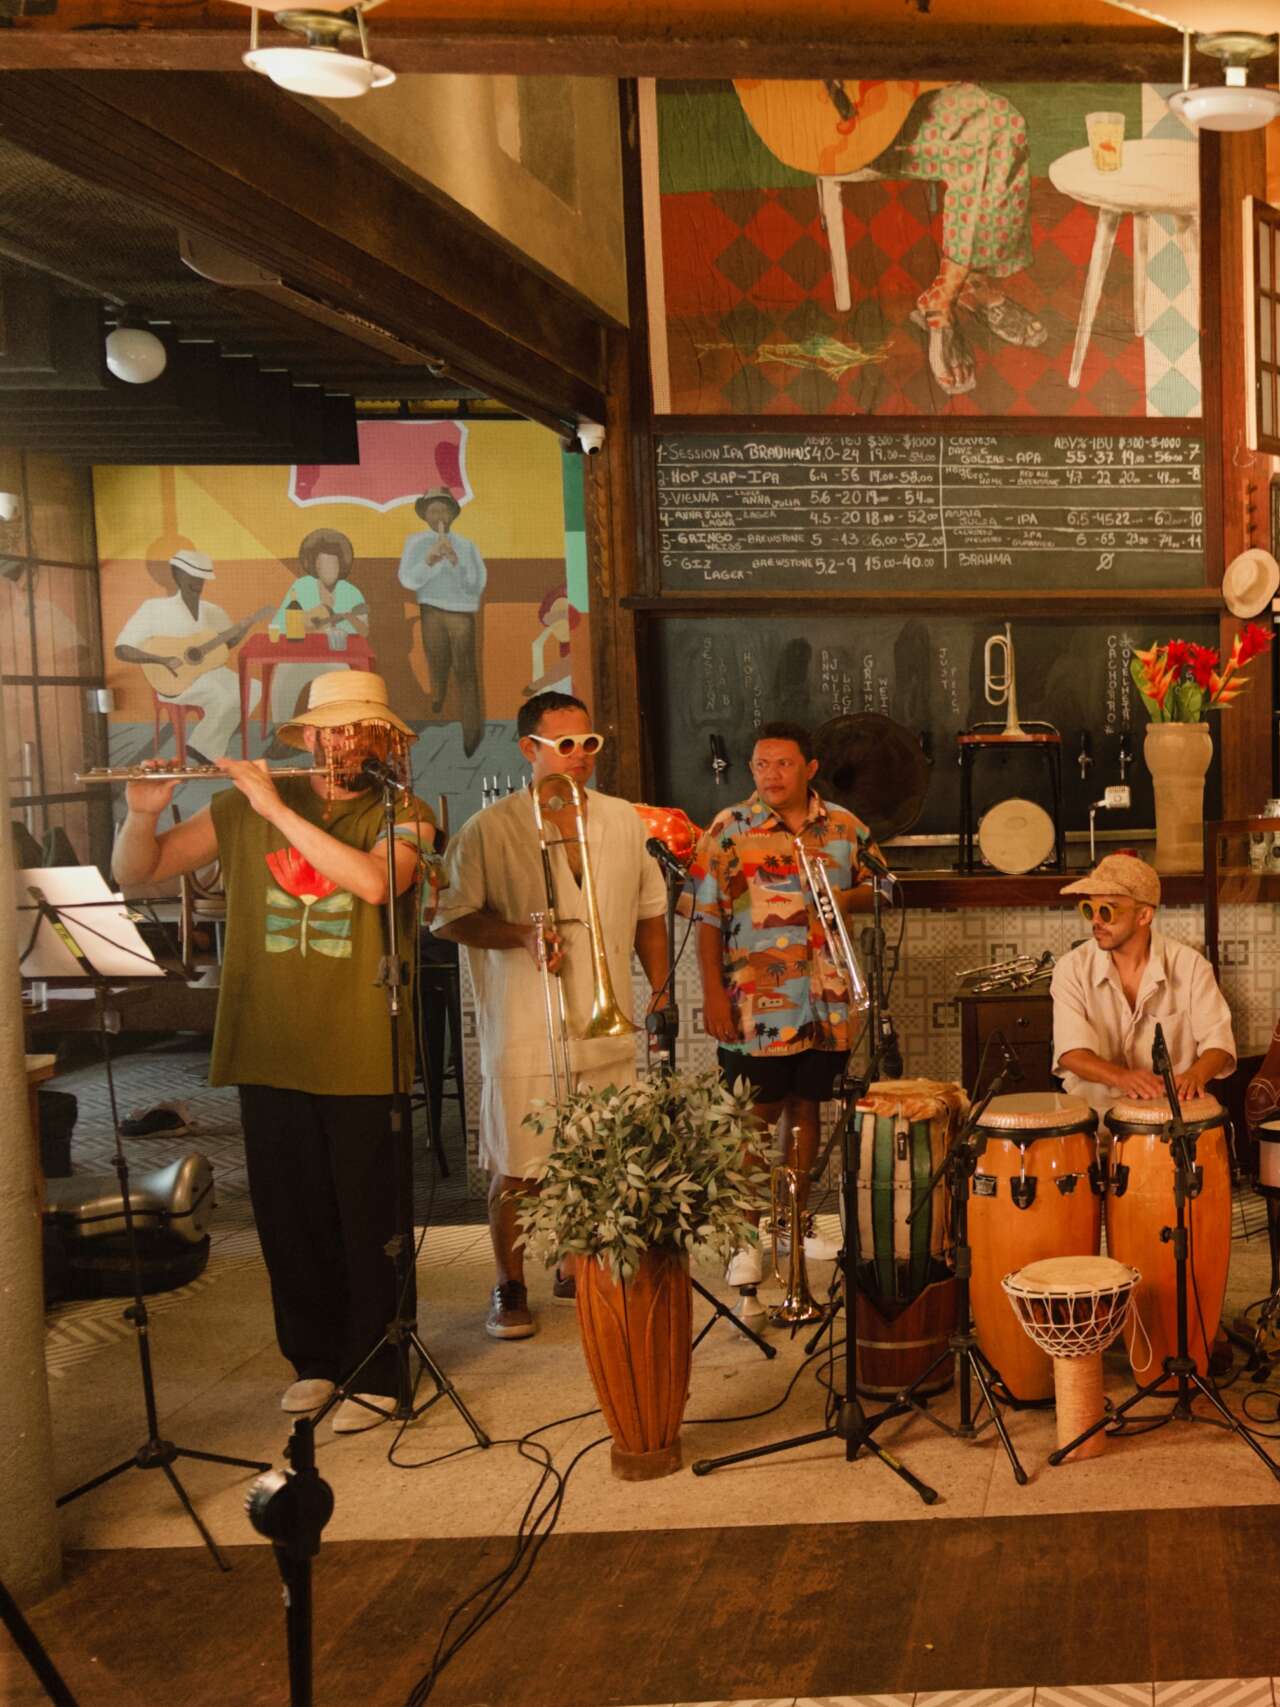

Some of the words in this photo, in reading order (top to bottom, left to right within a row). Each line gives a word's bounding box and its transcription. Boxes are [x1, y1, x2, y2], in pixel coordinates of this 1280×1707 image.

[669, 443, 720, 460] SESSION
[1016, 452, 1042, 464] APA
[671, 468, 699, 484] HOP
[671, 491, 720, 505] VIENNA
[1017, 513, 1038, 526] IPA
[677, 532, 733, 545] GRINGO
[958, 552, 1013, 567] BRAHMA
